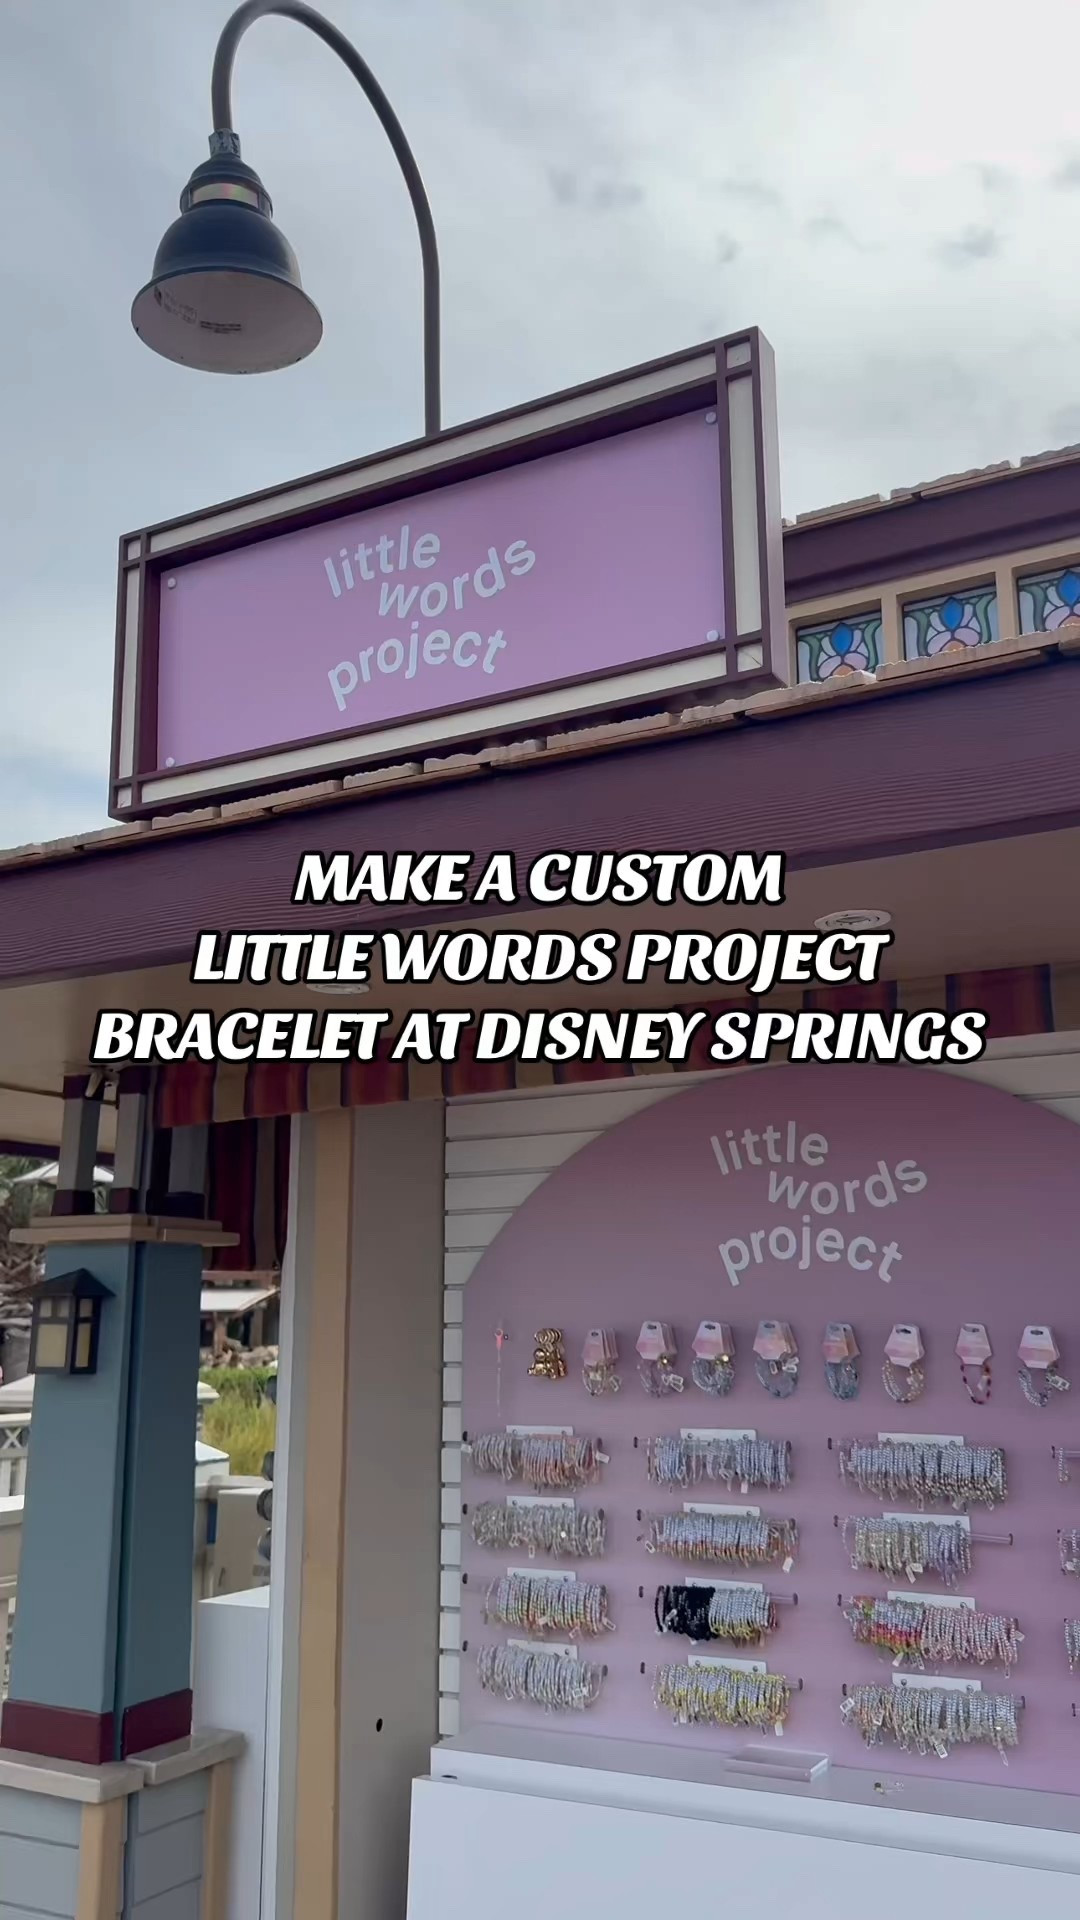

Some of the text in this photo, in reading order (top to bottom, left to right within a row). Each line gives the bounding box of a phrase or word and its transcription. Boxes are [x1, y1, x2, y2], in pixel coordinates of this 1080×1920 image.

[324, 525, 440, 598] little
[379, 540, 536, 619] words
[328, 621, 507, 712] project
[710, 1120, 829, 1176] little
[768, 1159, 928, 1215] words
[718, 1214, 903, 1287] project
